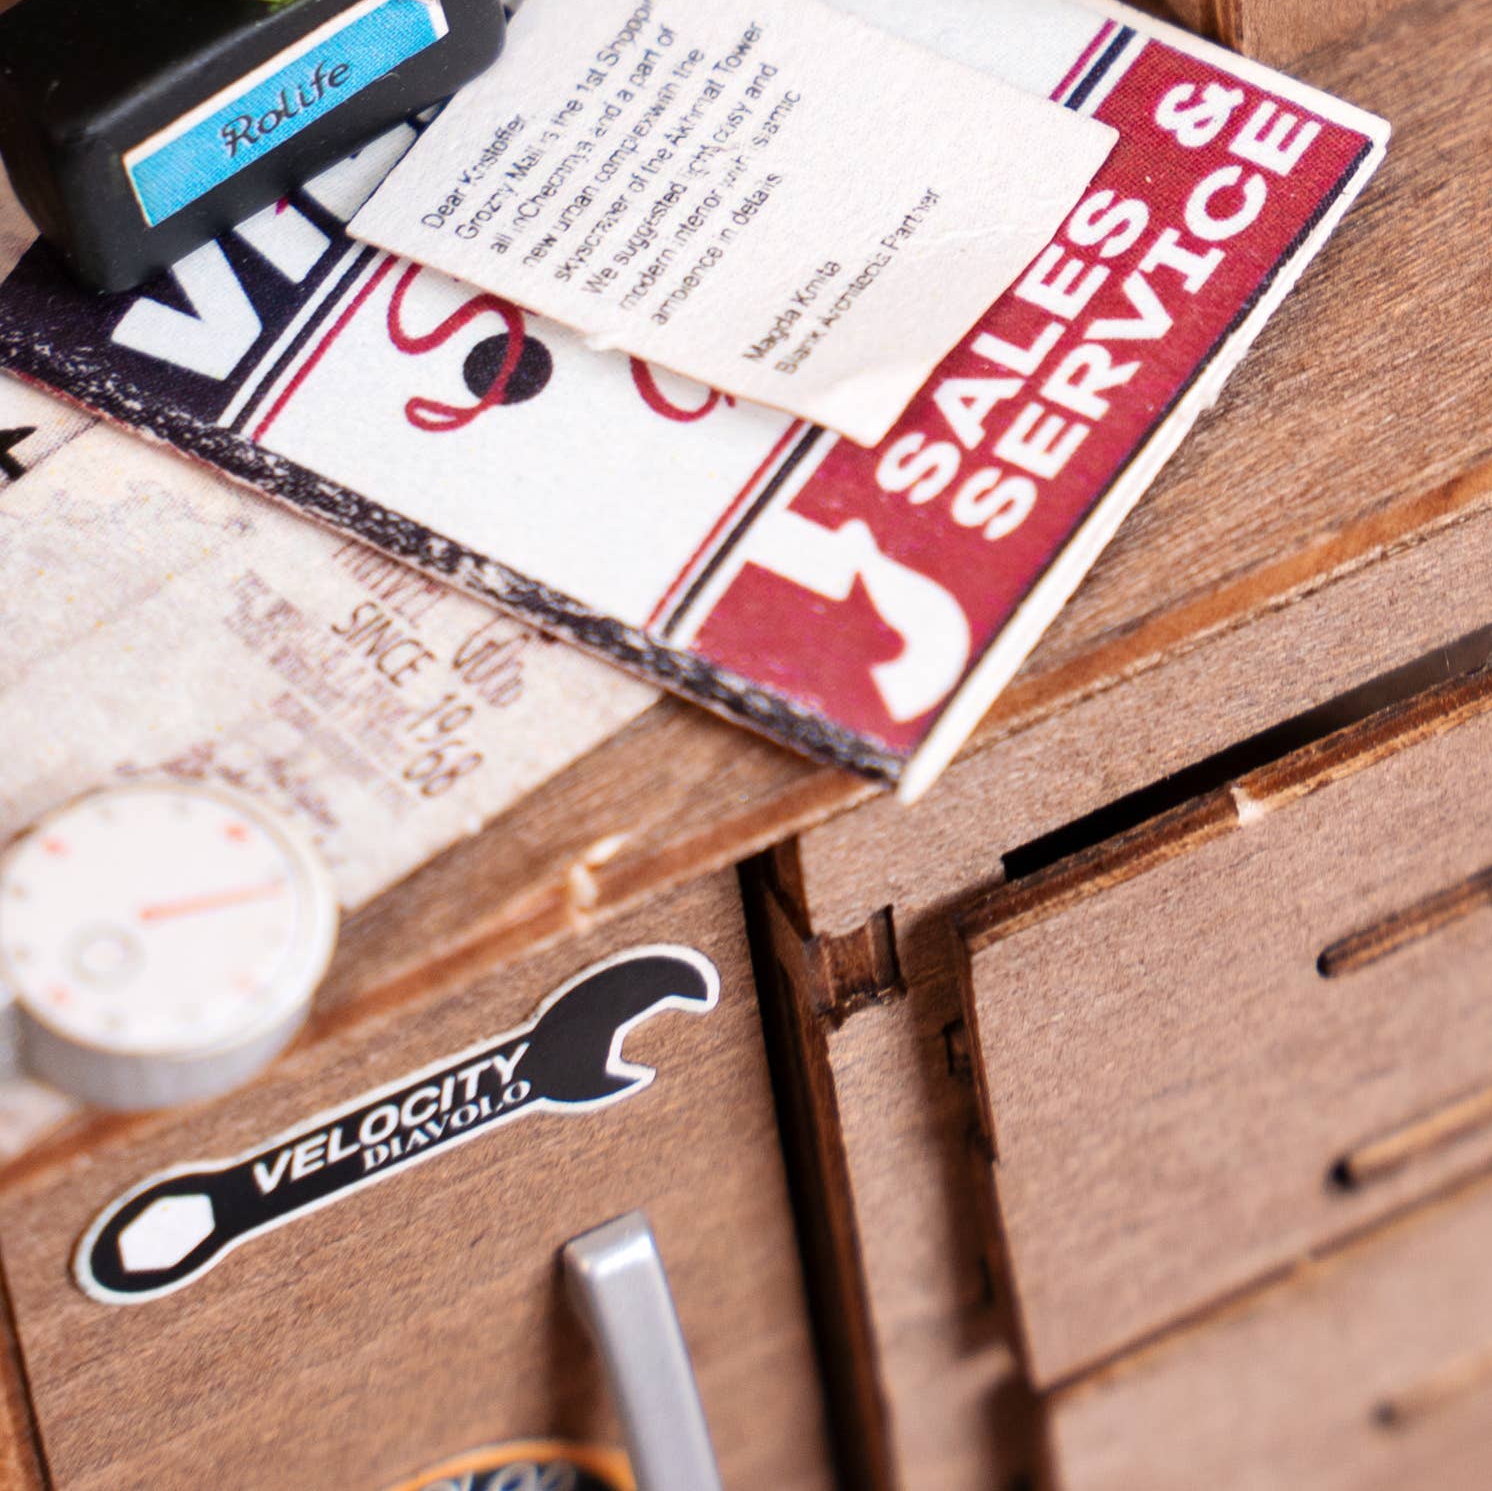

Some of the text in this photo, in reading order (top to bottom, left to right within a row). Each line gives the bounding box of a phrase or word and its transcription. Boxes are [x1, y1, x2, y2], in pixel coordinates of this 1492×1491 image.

[221, 60, 350, 157] Rolife
[549, 98, 584, 127] the
[574, 67, 609, 93] 1st
[585, 101, 623, 138] and
[615, 88, 635, 103] a
[625, 48, 664, 89] part
[653, 23, 679, 47] of
[625, 173, 650, 194] of
[639, 147, 674, 175] the
[711, 20, 765, 75] Tower
[419, 187, 468, 231] Dear
[520, 233, 559, 269] new
[550, 184, 599, 233] urban
[671, 48, 706, 80] the
[581, 266, 619, 296] We
[741, 61, 779, 100] and
[615, 247, 677, 311] modern
[670, 189, 724, 247] interior
[648, 245, 725, 326] ambience
[711, 226, 738, 245] in
[875, 82, 1246, 505] SALES &
[950, 99, 1323, 542] SERVICE
[331, 601, 437, 688] SINCE
[253, 1041, 532, 1197] VELOCITY
[362, 1080, 532, 1172] DIAVOLO
